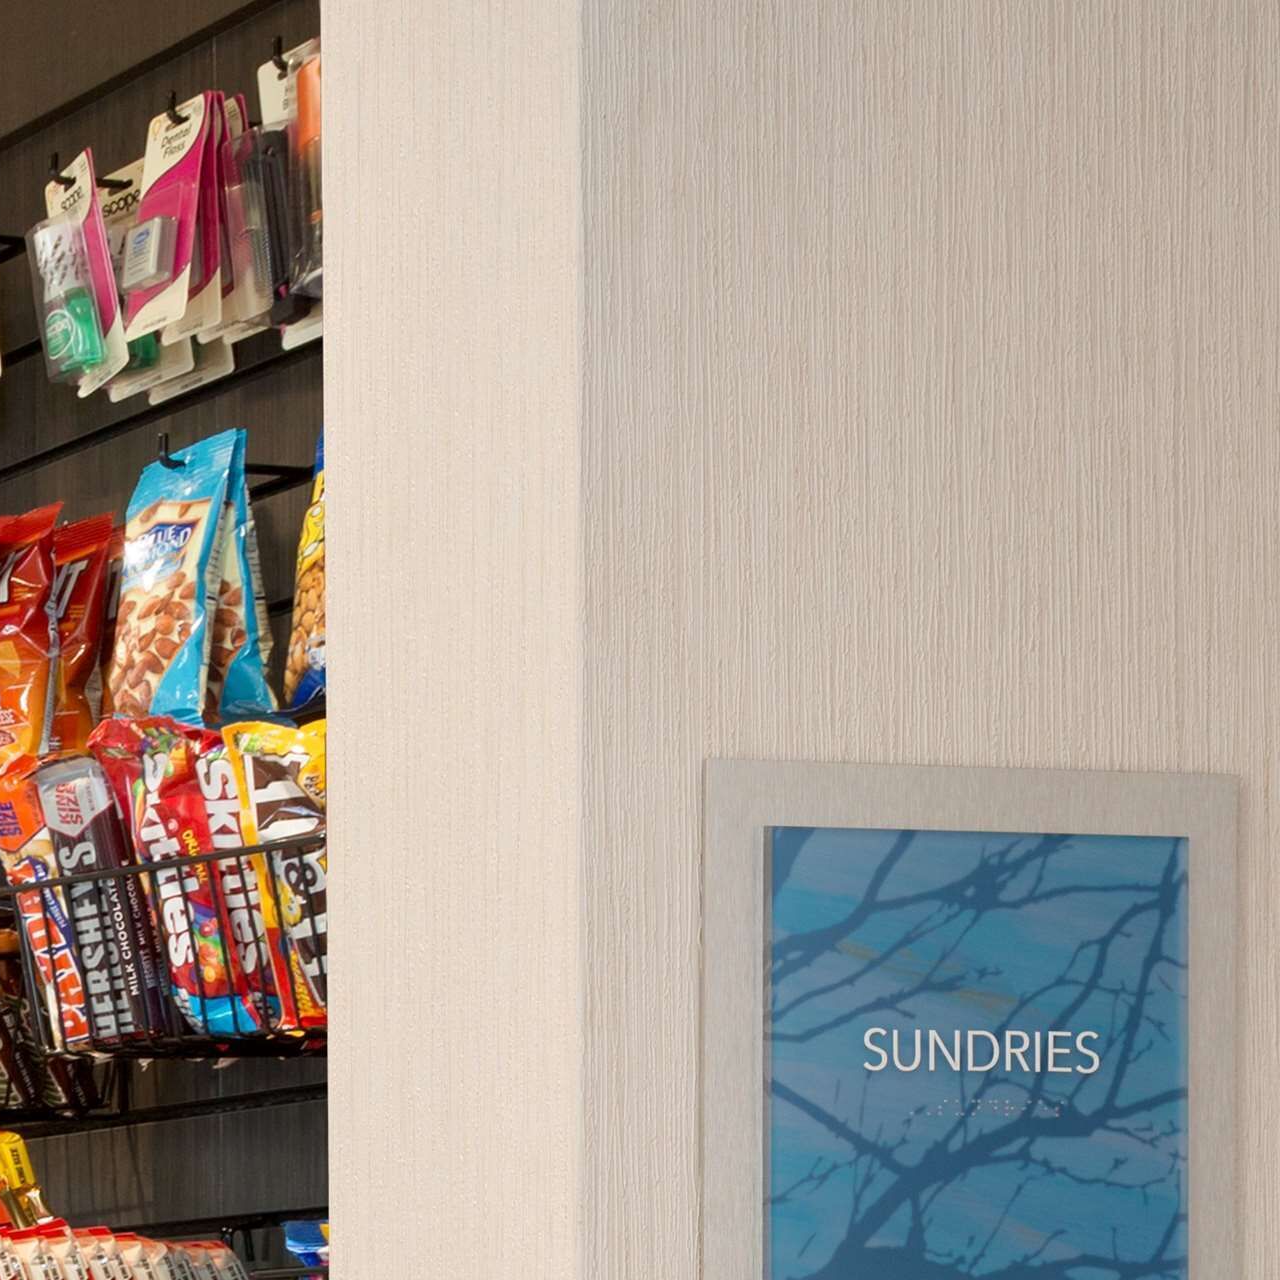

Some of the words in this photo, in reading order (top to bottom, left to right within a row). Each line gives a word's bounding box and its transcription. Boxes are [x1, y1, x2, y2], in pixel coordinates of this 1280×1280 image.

[160, 124, 191, 150] Dental
[162, 141, 186, 159] Floss
[102, 189, 140, 218] scope
[55, 784, 72, 825] KING
[66, 784, 83, 825] SIZE
[110, 878, 134, 966] CHOCOLATE
[123, 968, 140, 997] MILK
[862, 1027, 1102, 1076] SUNDRIES
